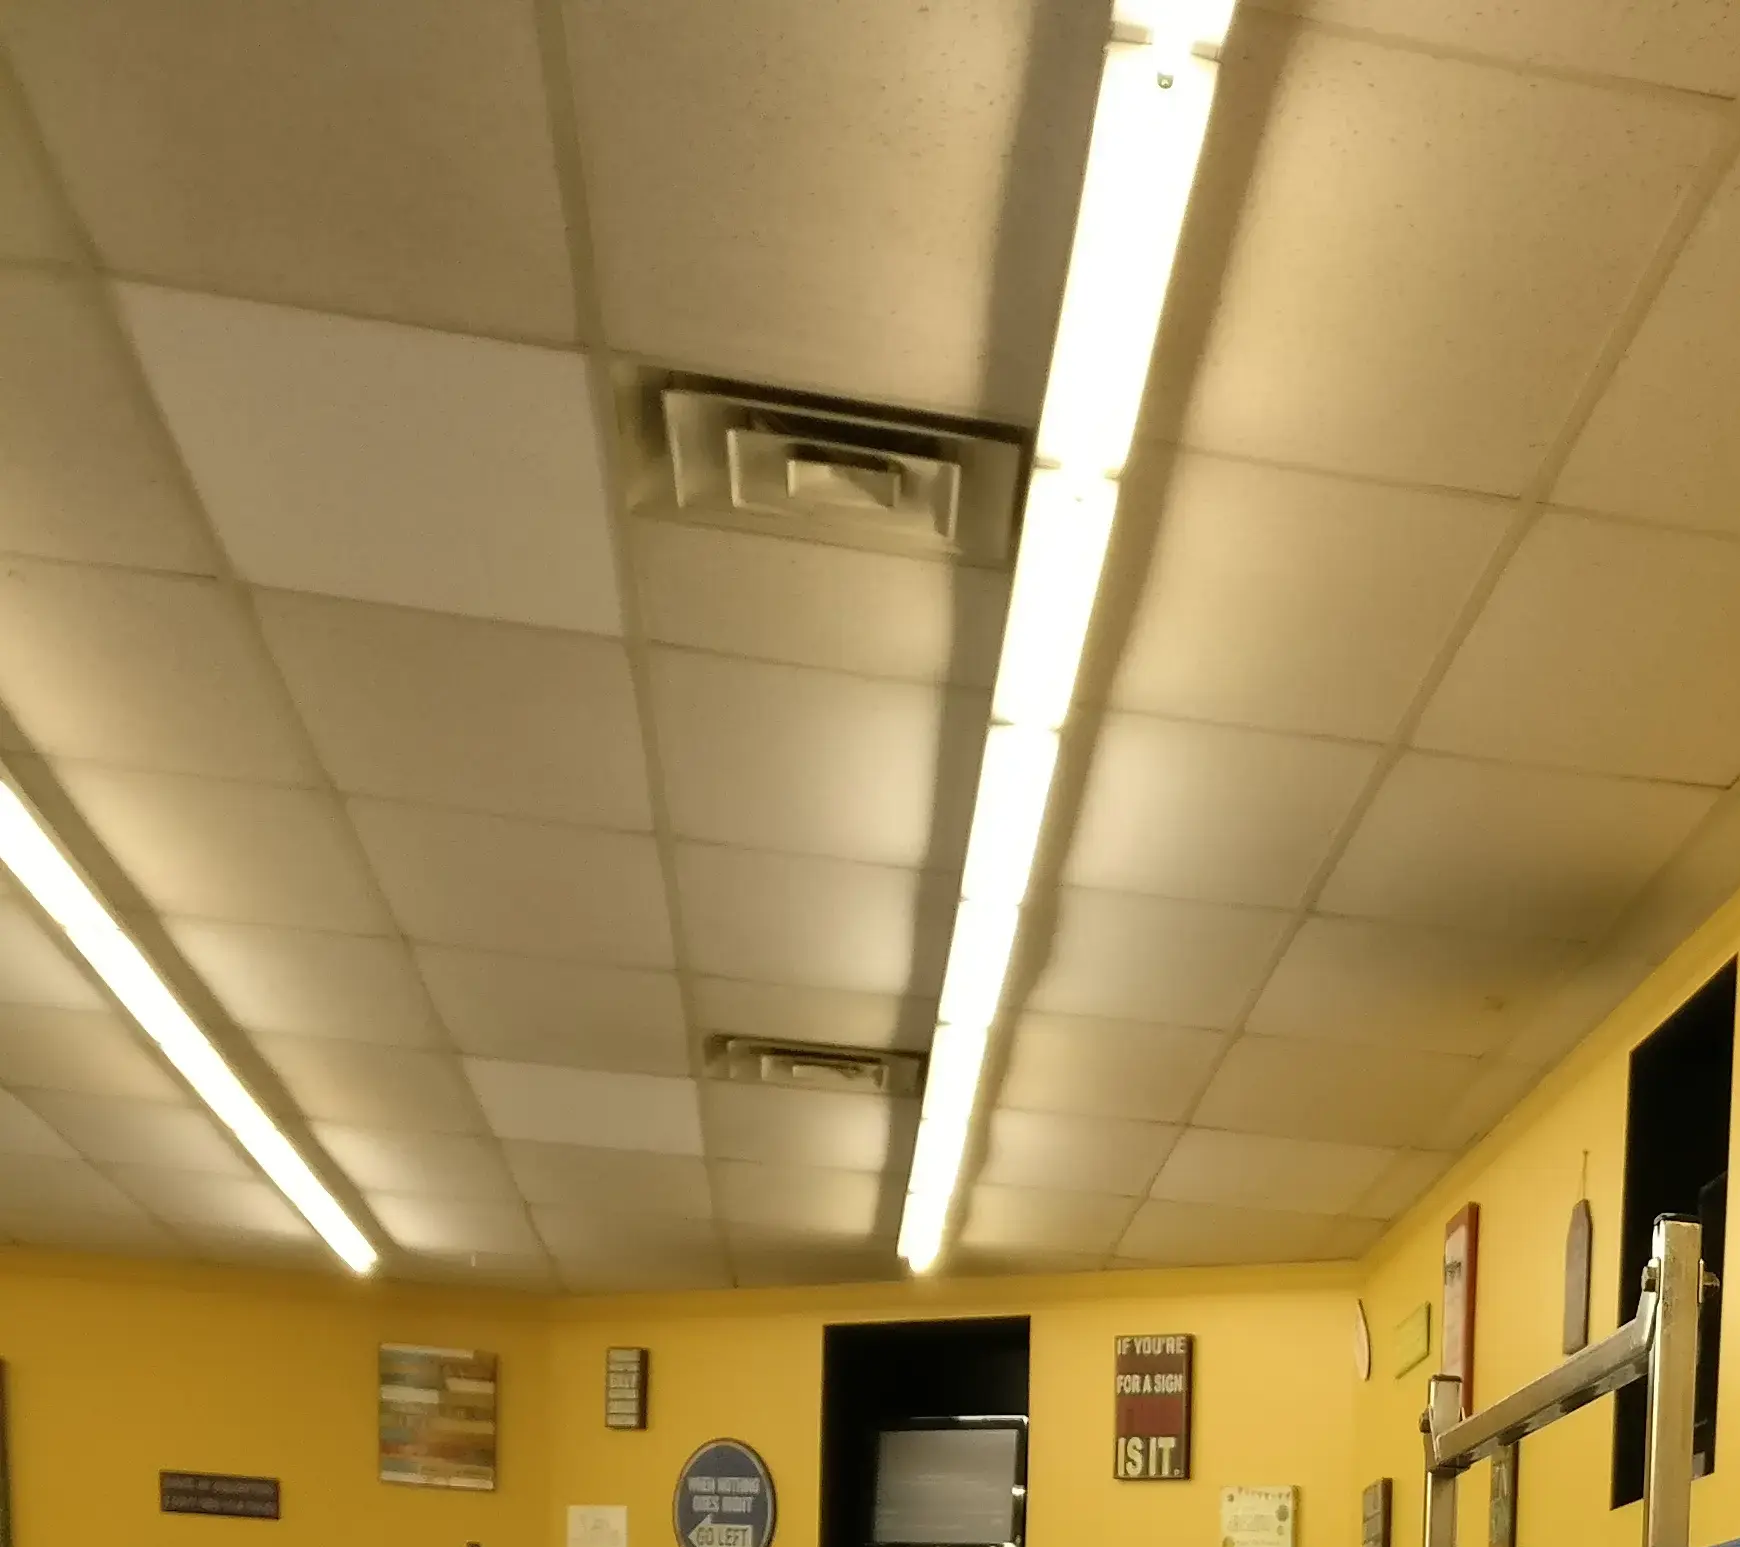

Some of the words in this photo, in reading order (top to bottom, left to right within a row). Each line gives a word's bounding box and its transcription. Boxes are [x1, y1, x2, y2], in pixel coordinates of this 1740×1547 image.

[1117, 1337, 1132, 1355] IF
[1134, 1336, 1186, 1355] YOU'RE
[1117, 1374, 1140, 1395] FOR
[1142, 1374, 1152, 1393] A
[1154, 1373, 1185, 1394] SIGN
[1117, 1436, 1142, 1477] IS
[1148, 1436, 1180, 1477] IT.
[697, 1527, 713, 1546] GO
[719, 1527, 749, 1546] LEFT
